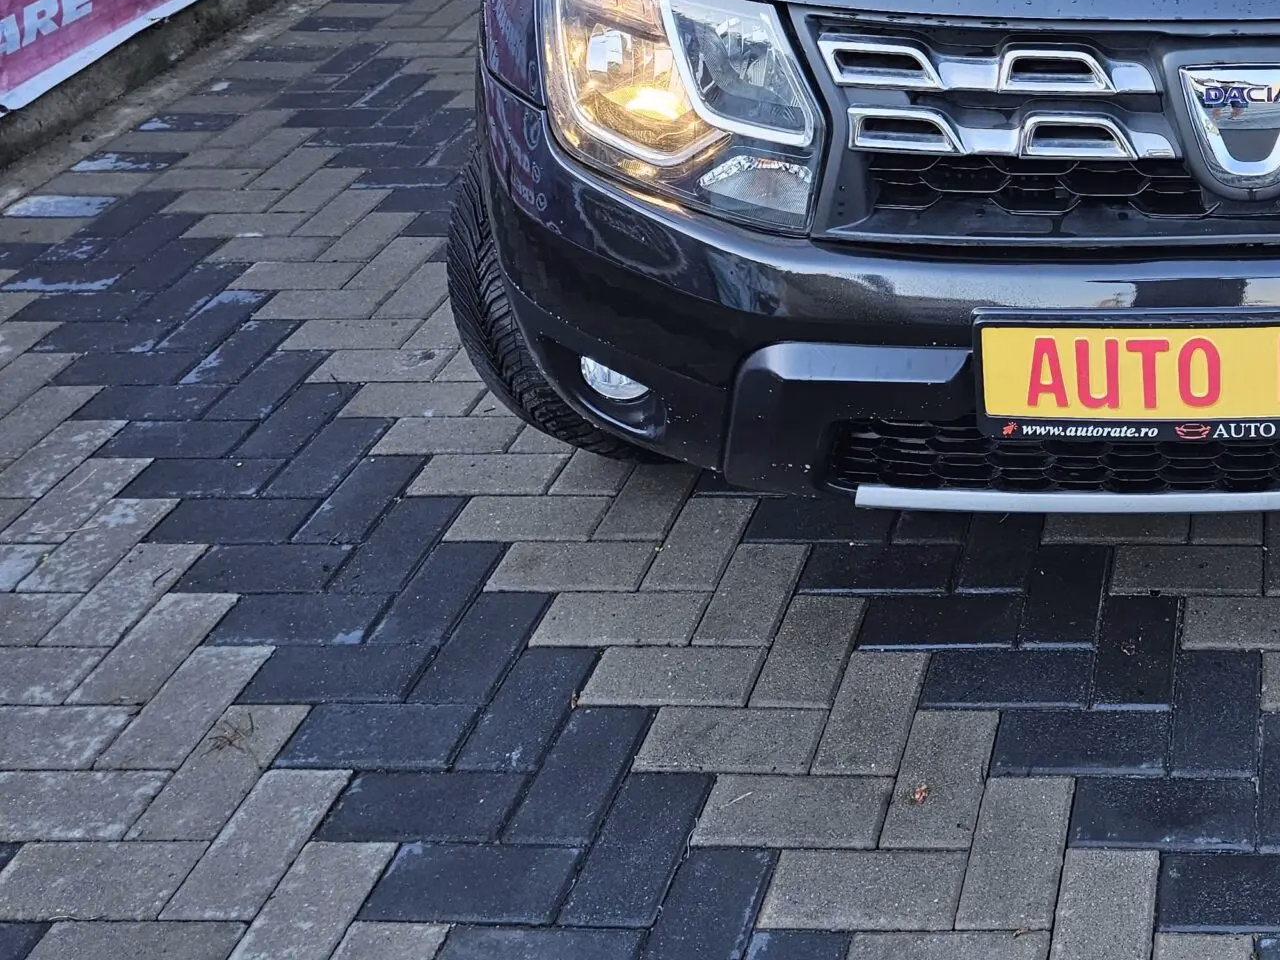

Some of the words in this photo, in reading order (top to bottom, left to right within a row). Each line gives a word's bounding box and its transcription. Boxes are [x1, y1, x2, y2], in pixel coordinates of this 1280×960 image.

[1027, 337, 1222, 410] AUTO
[1021, 423, 1159, 438] www.autorate.ro
[1213, 421, 1276, 439] AUTO
